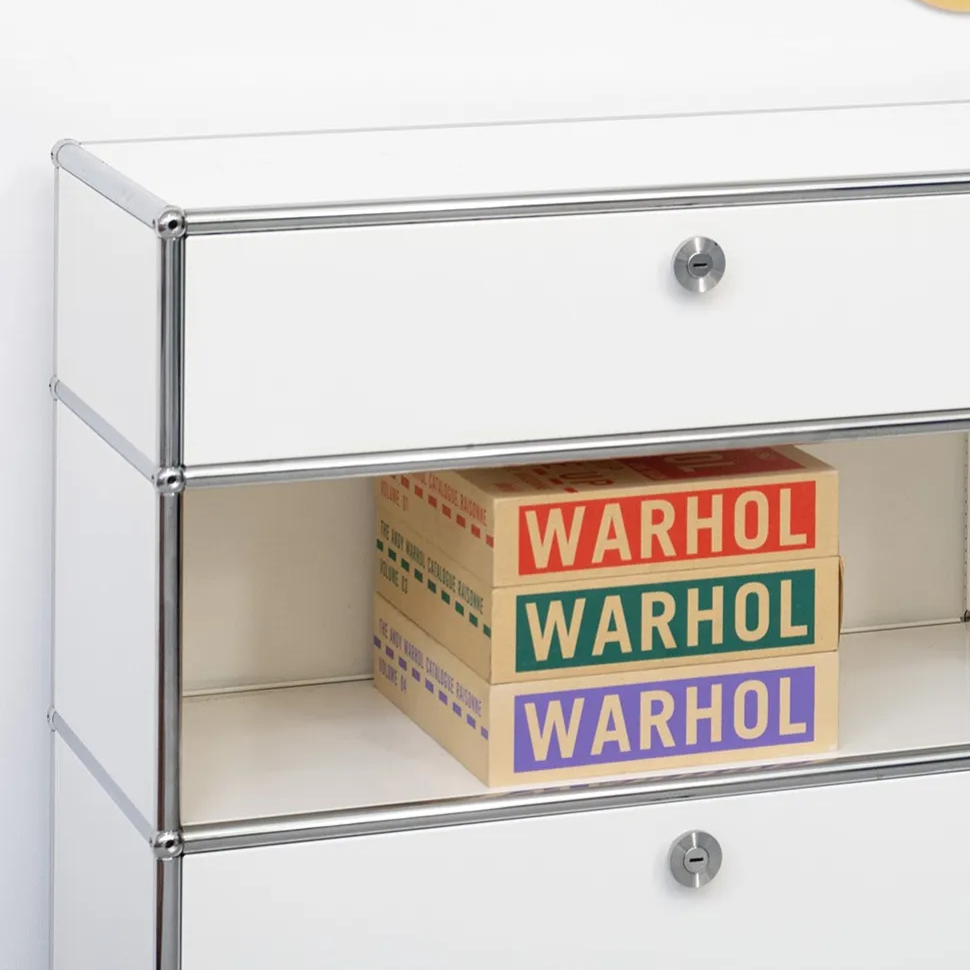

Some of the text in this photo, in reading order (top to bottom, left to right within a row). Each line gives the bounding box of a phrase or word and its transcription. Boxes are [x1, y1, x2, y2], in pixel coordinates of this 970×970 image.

[525, 487, 807, 570] WARHOL
[525, 579, 808, 662] WARHOL
[524, 676, 807, 762] WARHOL
